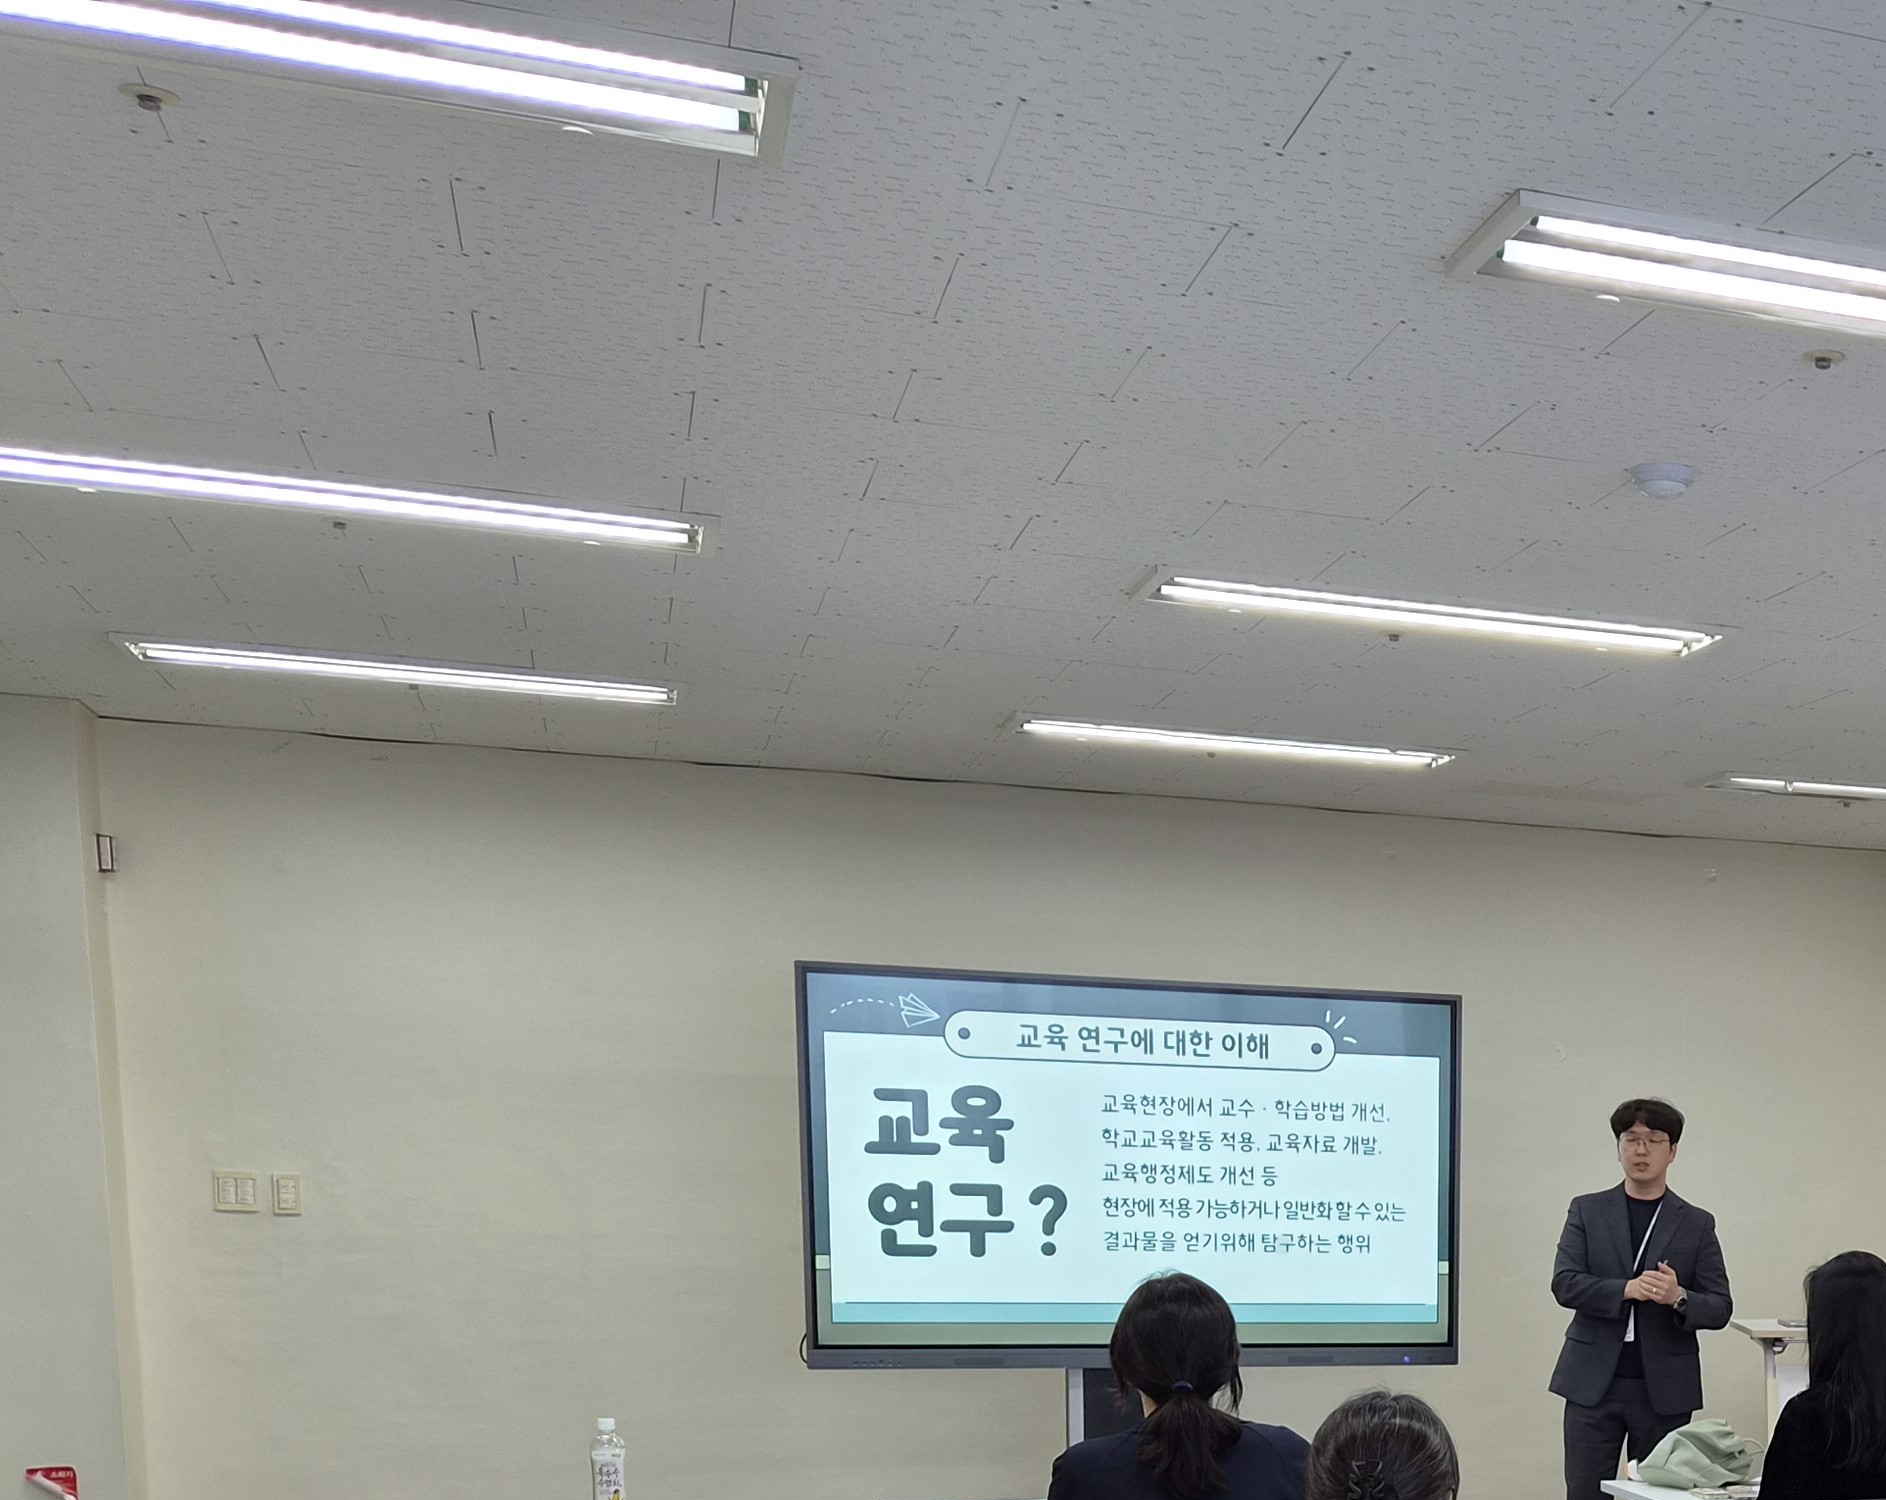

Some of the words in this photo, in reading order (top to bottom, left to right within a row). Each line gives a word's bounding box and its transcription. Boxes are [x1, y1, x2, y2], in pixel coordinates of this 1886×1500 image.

[1016, 1023, 1069, 1052] 교육
[1078, 1026, 1154, 1056] 연구에
[1163, 1029, 1214, 1058] 대한
[1221, 1032, 1269, 1060] 이해
[1101, 1094, 1212, 1118] 교육현장에서
[1219, 1098, 1256, 1118] 교수
[1275, 1099, 1345, 1122] 학습방법
[864, 1085, 1014, 1164] 교육
[1102, 1128, 1214, 1152] 학교교육활동
[1266, 1132, 1338, 1154] 교육자료
[1102, 1162, 1214, 1185] 교육행정제도
[1220, 1165, 1254, 1186] 개선
[1261, 1166, 1278, 1186] 등
[1102, 1196, 1154, 1218] 현장에
[1158, 1198, 1192, 1219] 적용
[1196, 1199, 1280, 1220] 가능하거나
[1374, 1202, 1406, 1222] 있는
[1104, 1231, 1177, 1252] 결과물을
[1260, 1233, 1332, 1254] 탐구하는
[1337, 1234, 1370, 1254] 행위
